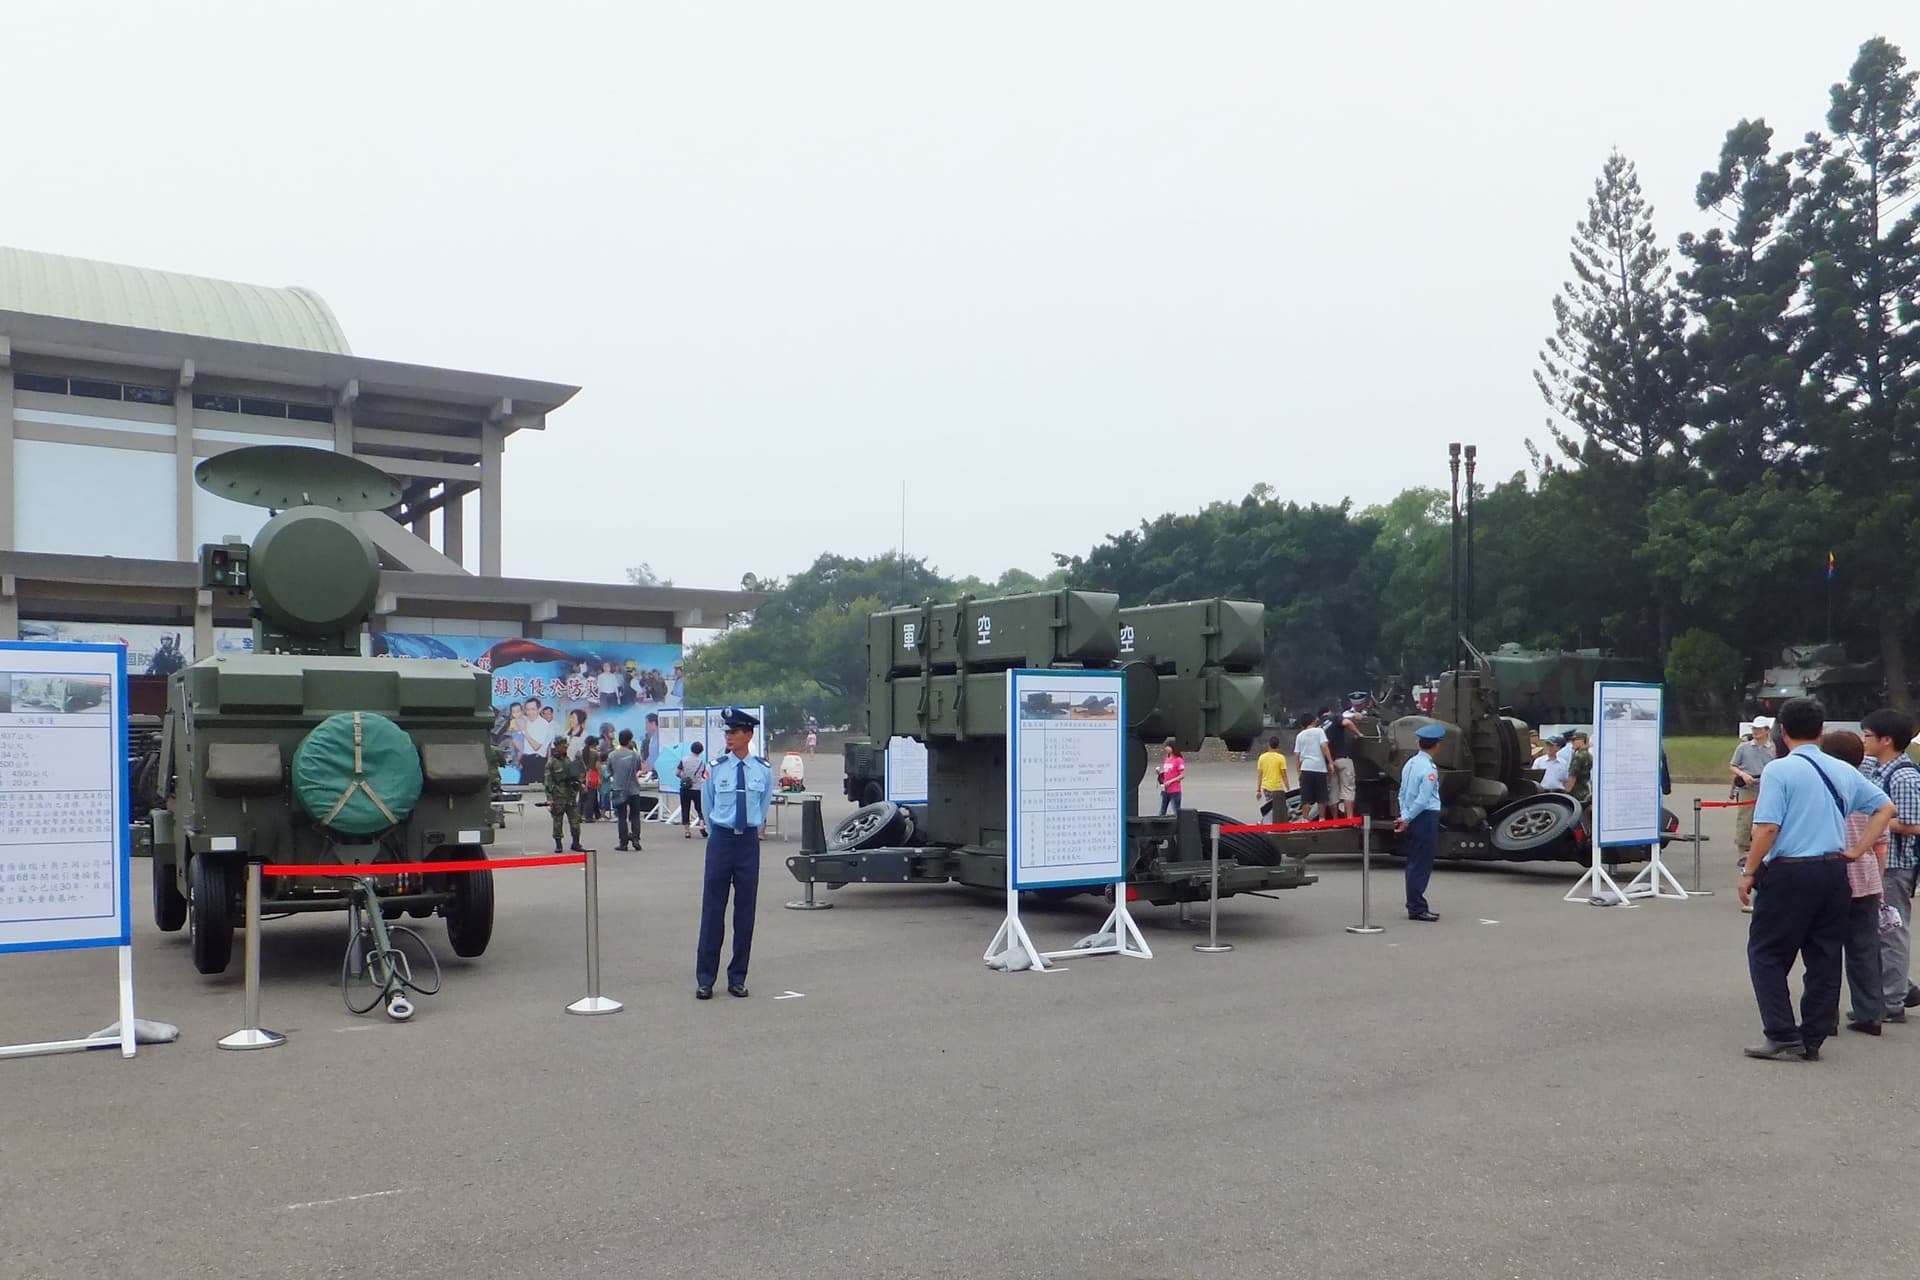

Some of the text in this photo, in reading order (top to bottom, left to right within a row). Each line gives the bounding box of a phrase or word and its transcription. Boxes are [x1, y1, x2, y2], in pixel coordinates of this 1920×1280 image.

[903, 615, 992, 650] 軍 空
[1119, 625, 1135, 653] 空
